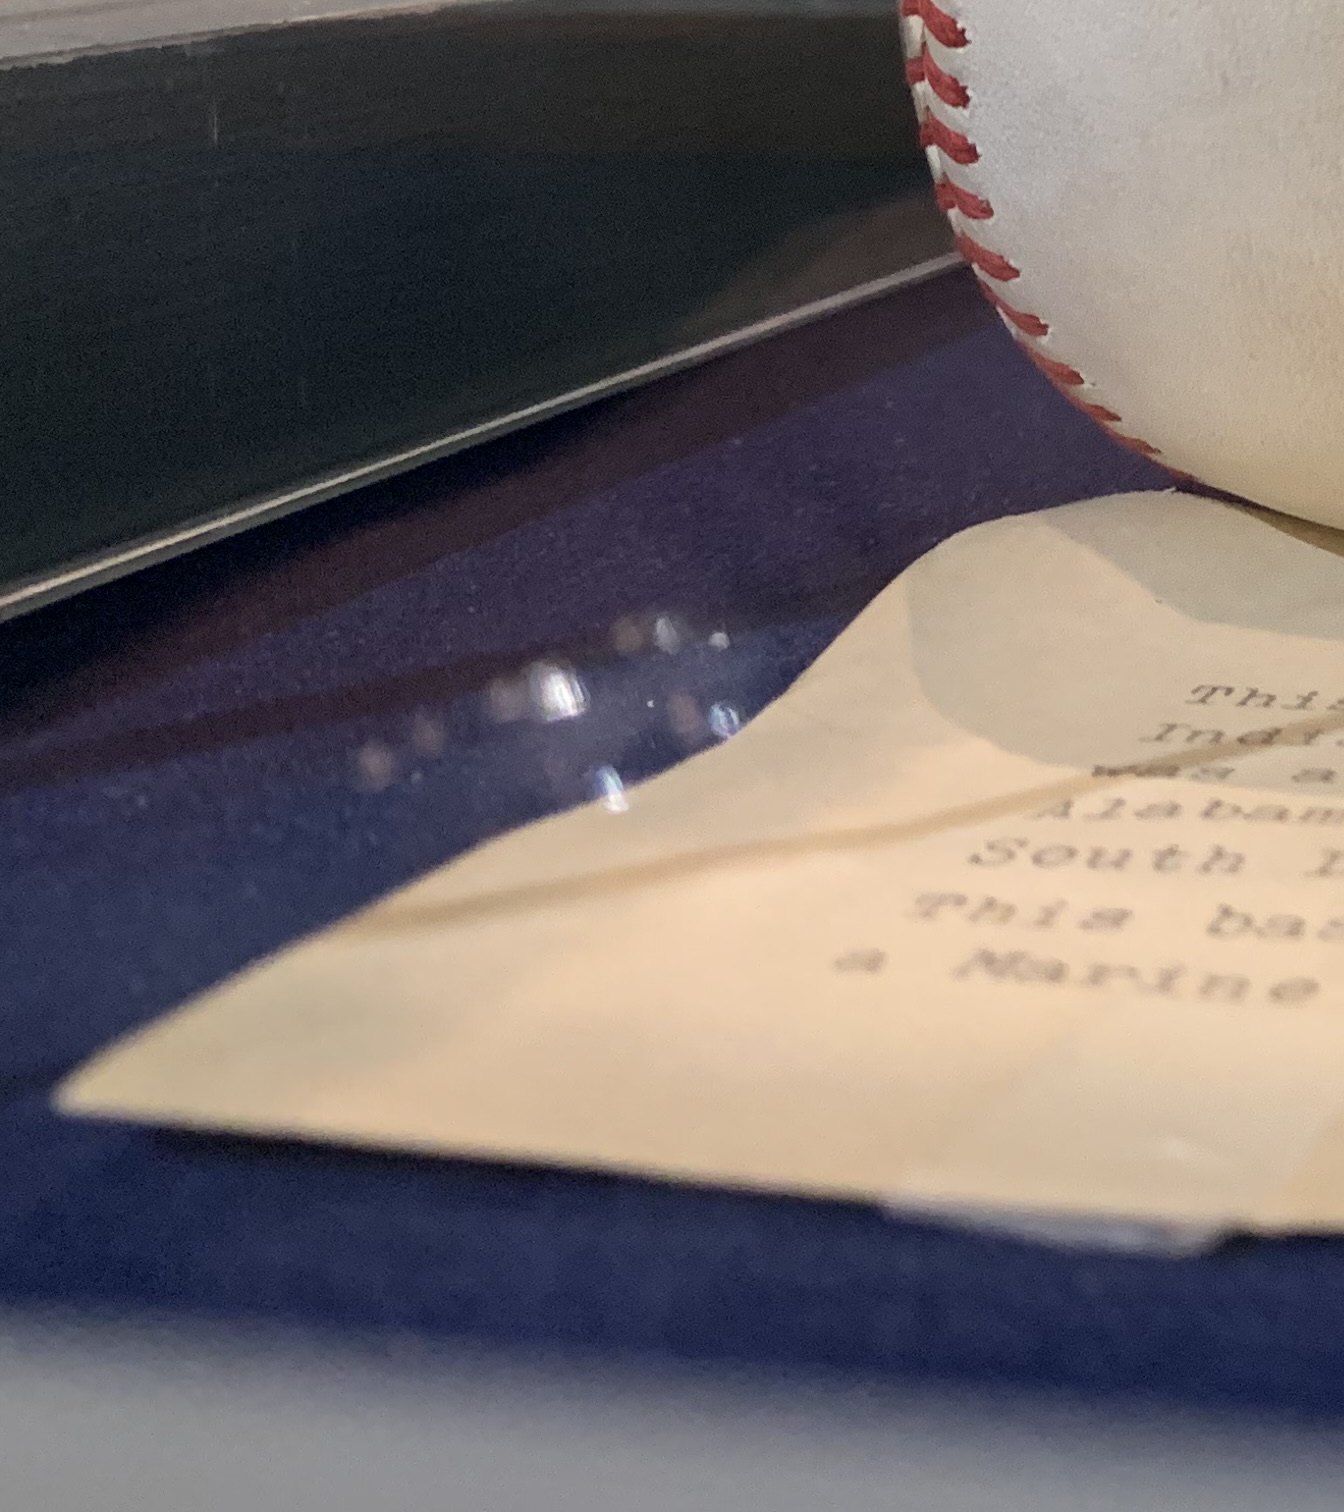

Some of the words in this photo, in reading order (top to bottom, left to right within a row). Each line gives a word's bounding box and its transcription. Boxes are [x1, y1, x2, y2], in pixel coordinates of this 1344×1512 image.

[1088, 760, 1236, 782] was
[966, 838, 1248, 878] South
[908, 892, 1134, 934] This
[950, 946, 1322, 1006] Marine
